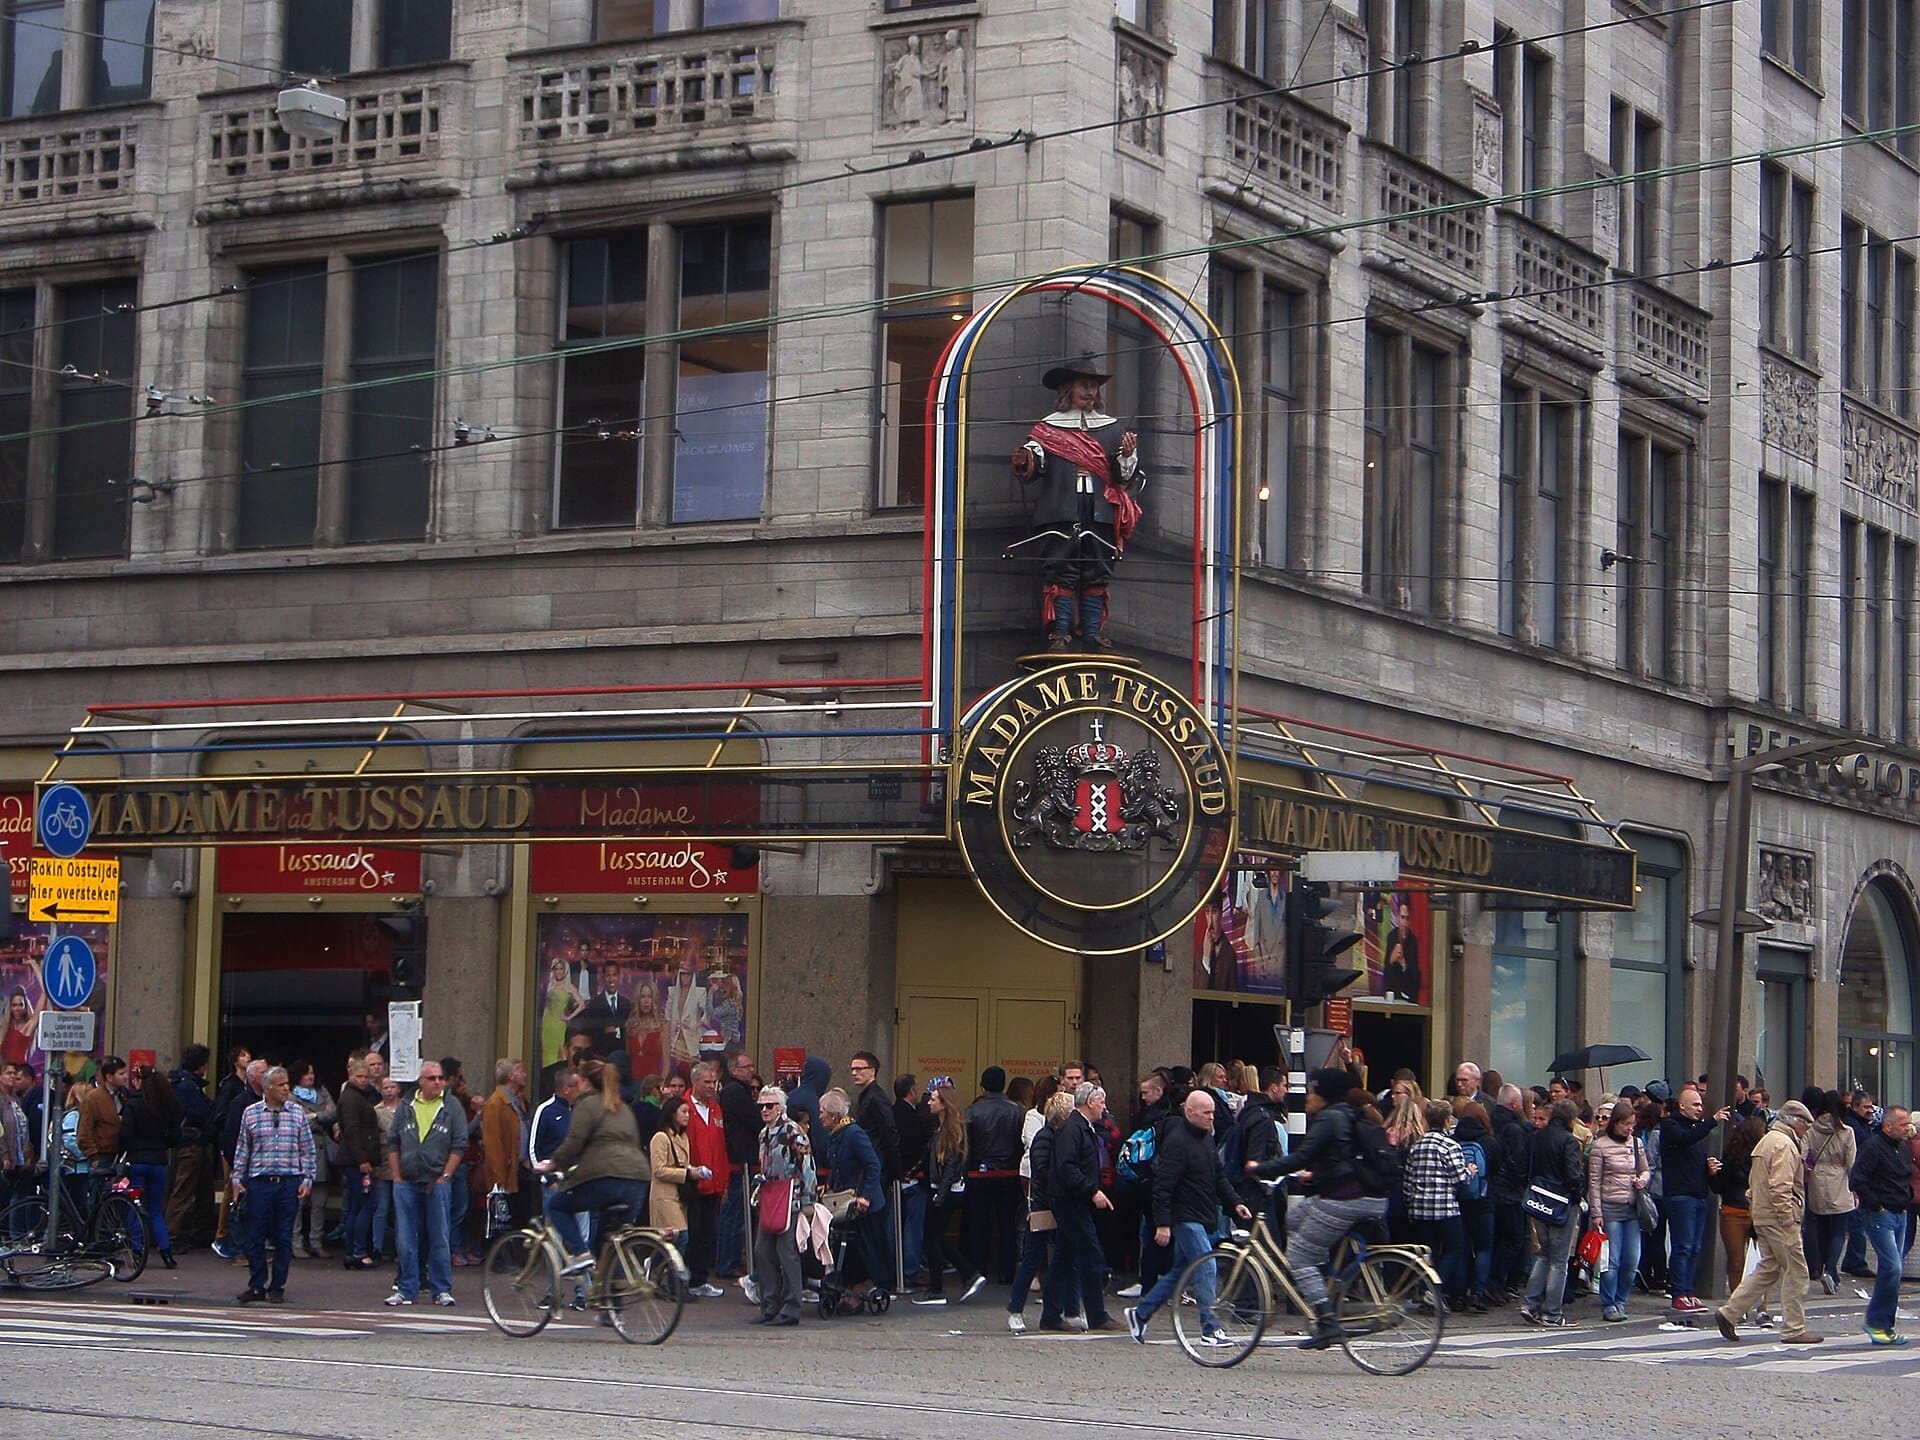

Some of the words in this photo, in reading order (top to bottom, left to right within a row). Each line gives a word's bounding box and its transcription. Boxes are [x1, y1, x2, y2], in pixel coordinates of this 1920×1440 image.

[966, 673, 1099, 809] MADAME
[1111, 674, 1226, 816] TUSSAUD
[304, 785, 533, 832] TUSSAUD
[580, 787, 696, 827] Madame
[1253, 796, 1375, 852] MADAME
[1385, 819, 1491, 877] TUSSAUD
[31, 860, 63, 877] Rokin
[67, 861, 118, 883] Oostzijde
[600, 831, 710, 888] Tussauds
[31, 883, 53, 899] hier
[57, 886, 115, 901] oversteken
[304, 876, 356, 887] AMSTERDAM
[627, 876, 684, 886] AMSTERDAM
